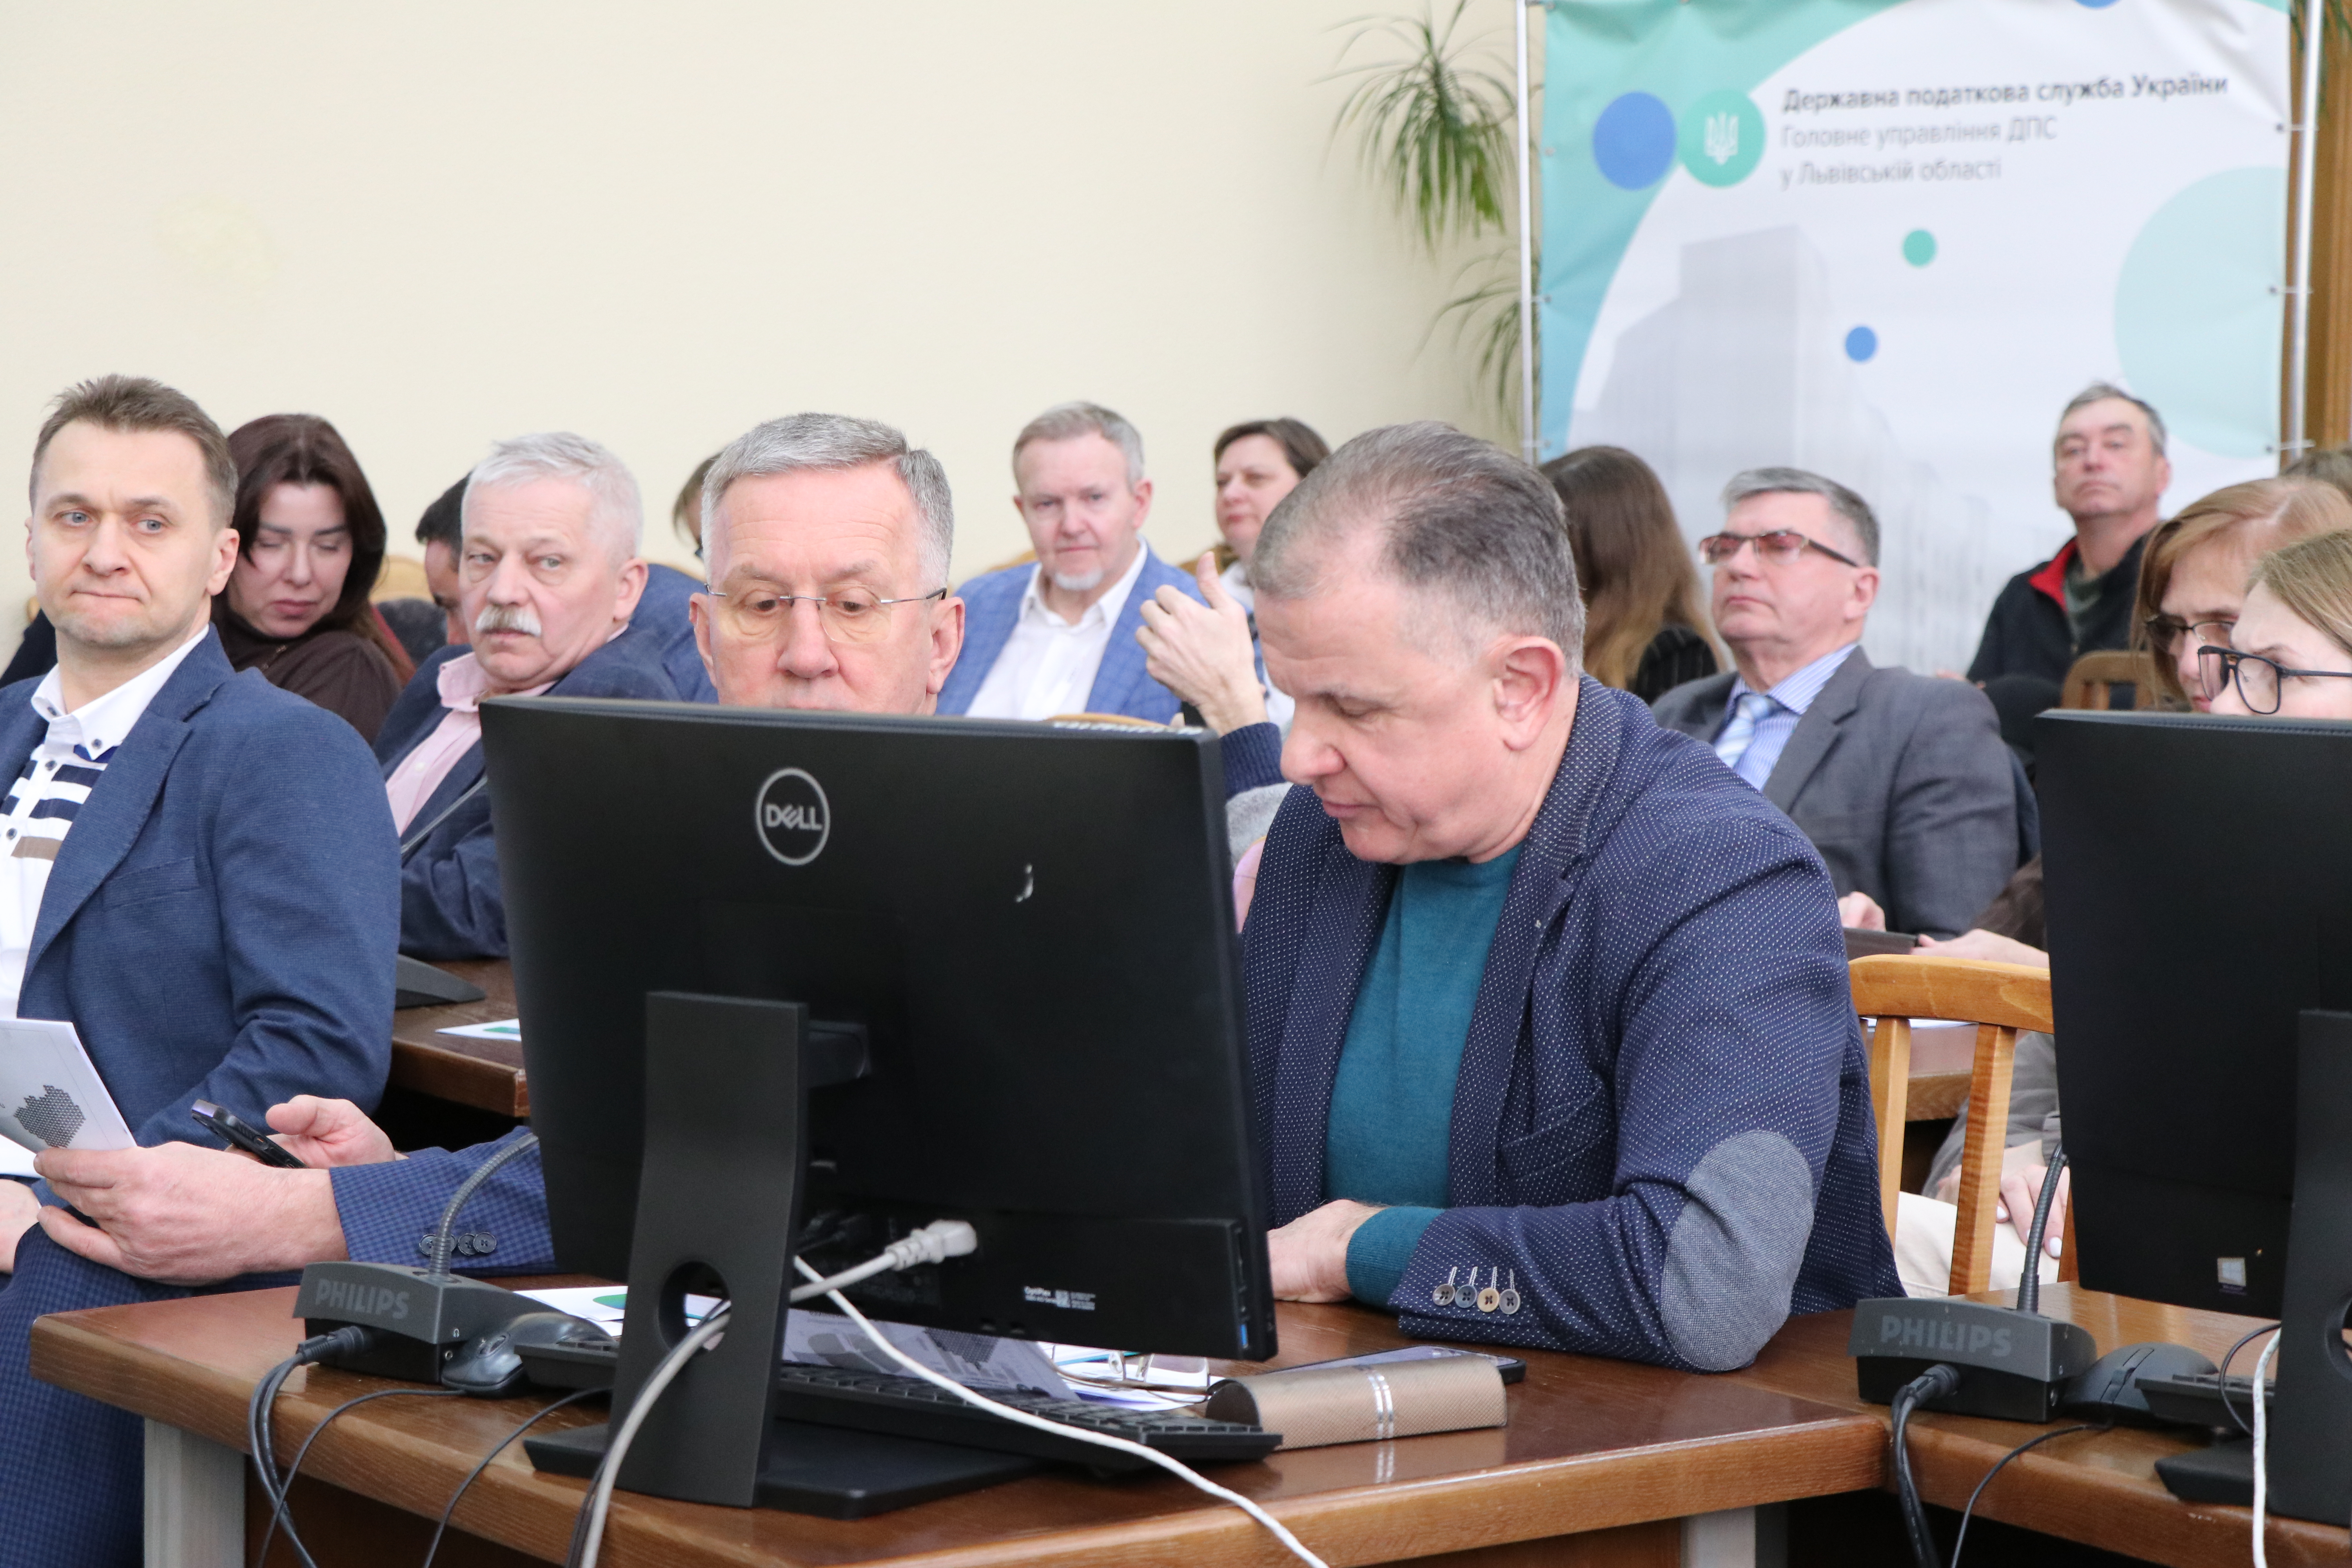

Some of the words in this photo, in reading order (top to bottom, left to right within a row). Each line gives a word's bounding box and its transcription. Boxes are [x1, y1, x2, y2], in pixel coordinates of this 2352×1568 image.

[1783, 87, 1900, 114] Державна
[1906, 84, 2029, 109] податкова
[2037, 75, 2124, 106] служба
[2131, 71, 2227, 102] України
[1781, 124, 1871, 148] Головне
[1875, 121, 2001, 151] управління
[2006, 115, 2057, 143] ДПС
[1780, 167, 1793, 192] у
[1798, 159, 1915, 185] Львівській
[1919, 156, 2002, 181] області
[766, 804, 823, 831] DELL
[315, 1278, 410, 1319] PHILIPS
[1881, 1315, 2012, 1357] PHILIPS
